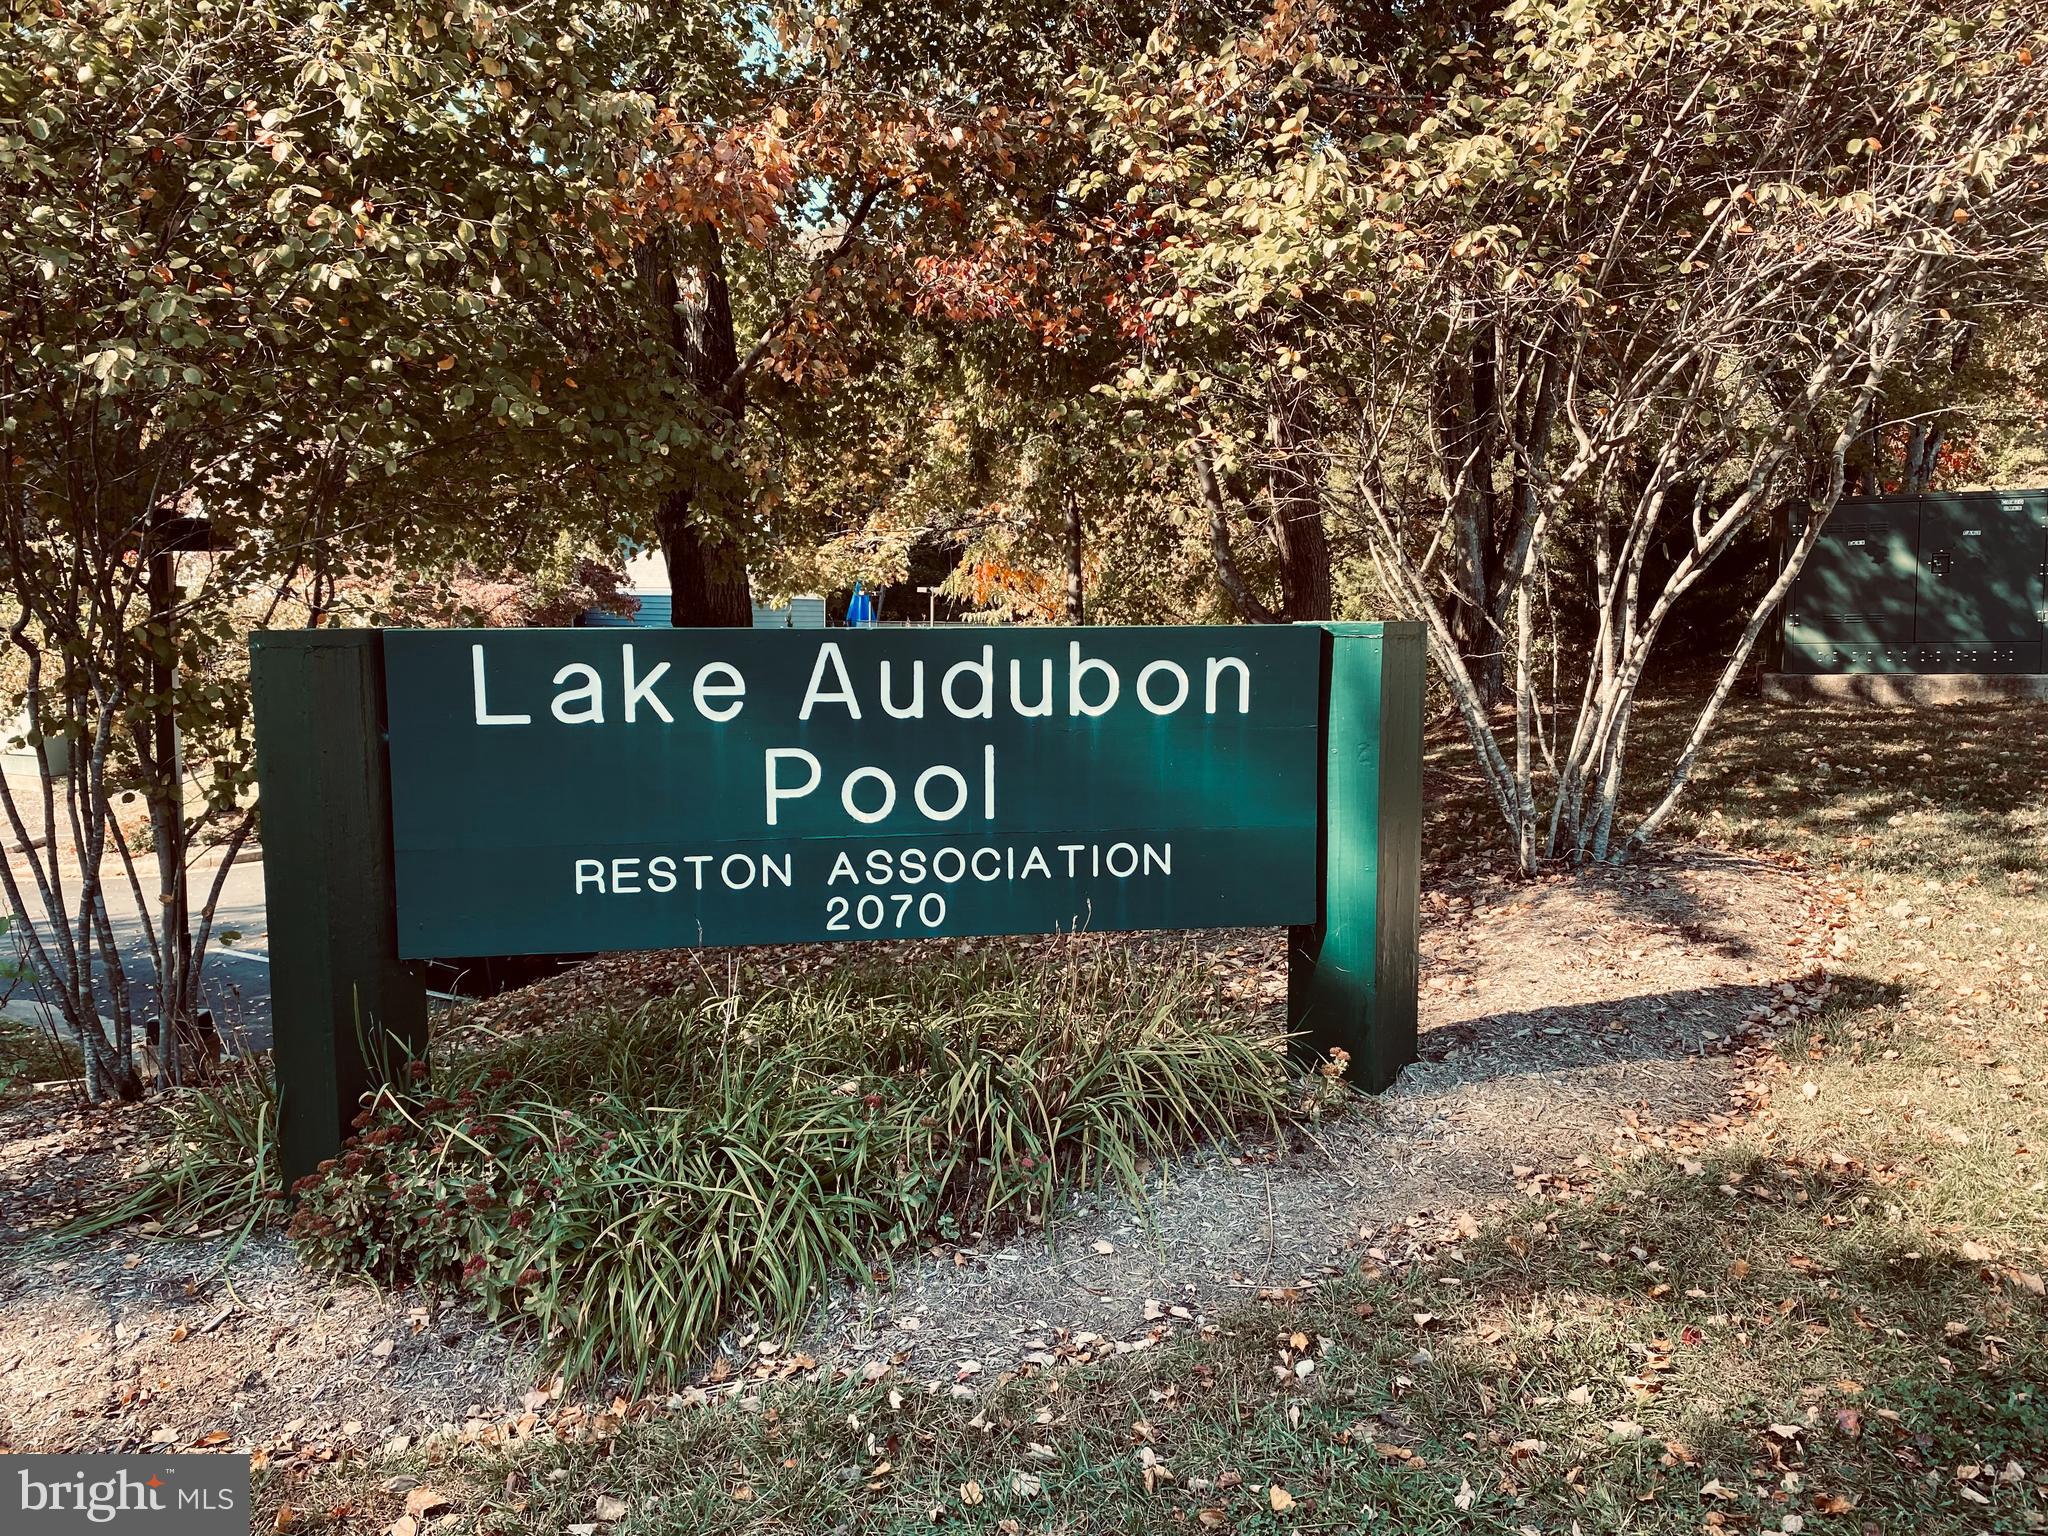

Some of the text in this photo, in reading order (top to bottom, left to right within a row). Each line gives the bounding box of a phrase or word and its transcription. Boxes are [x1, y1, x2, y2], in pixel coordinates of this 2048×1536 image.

[473, 640, 1252, 727] Lake Audubon
[764, 744, 996, 826] Pool
[575, 842, 1172, 895] RESTON ASSOCIATION
[826, 892, 947, 931] 2070
